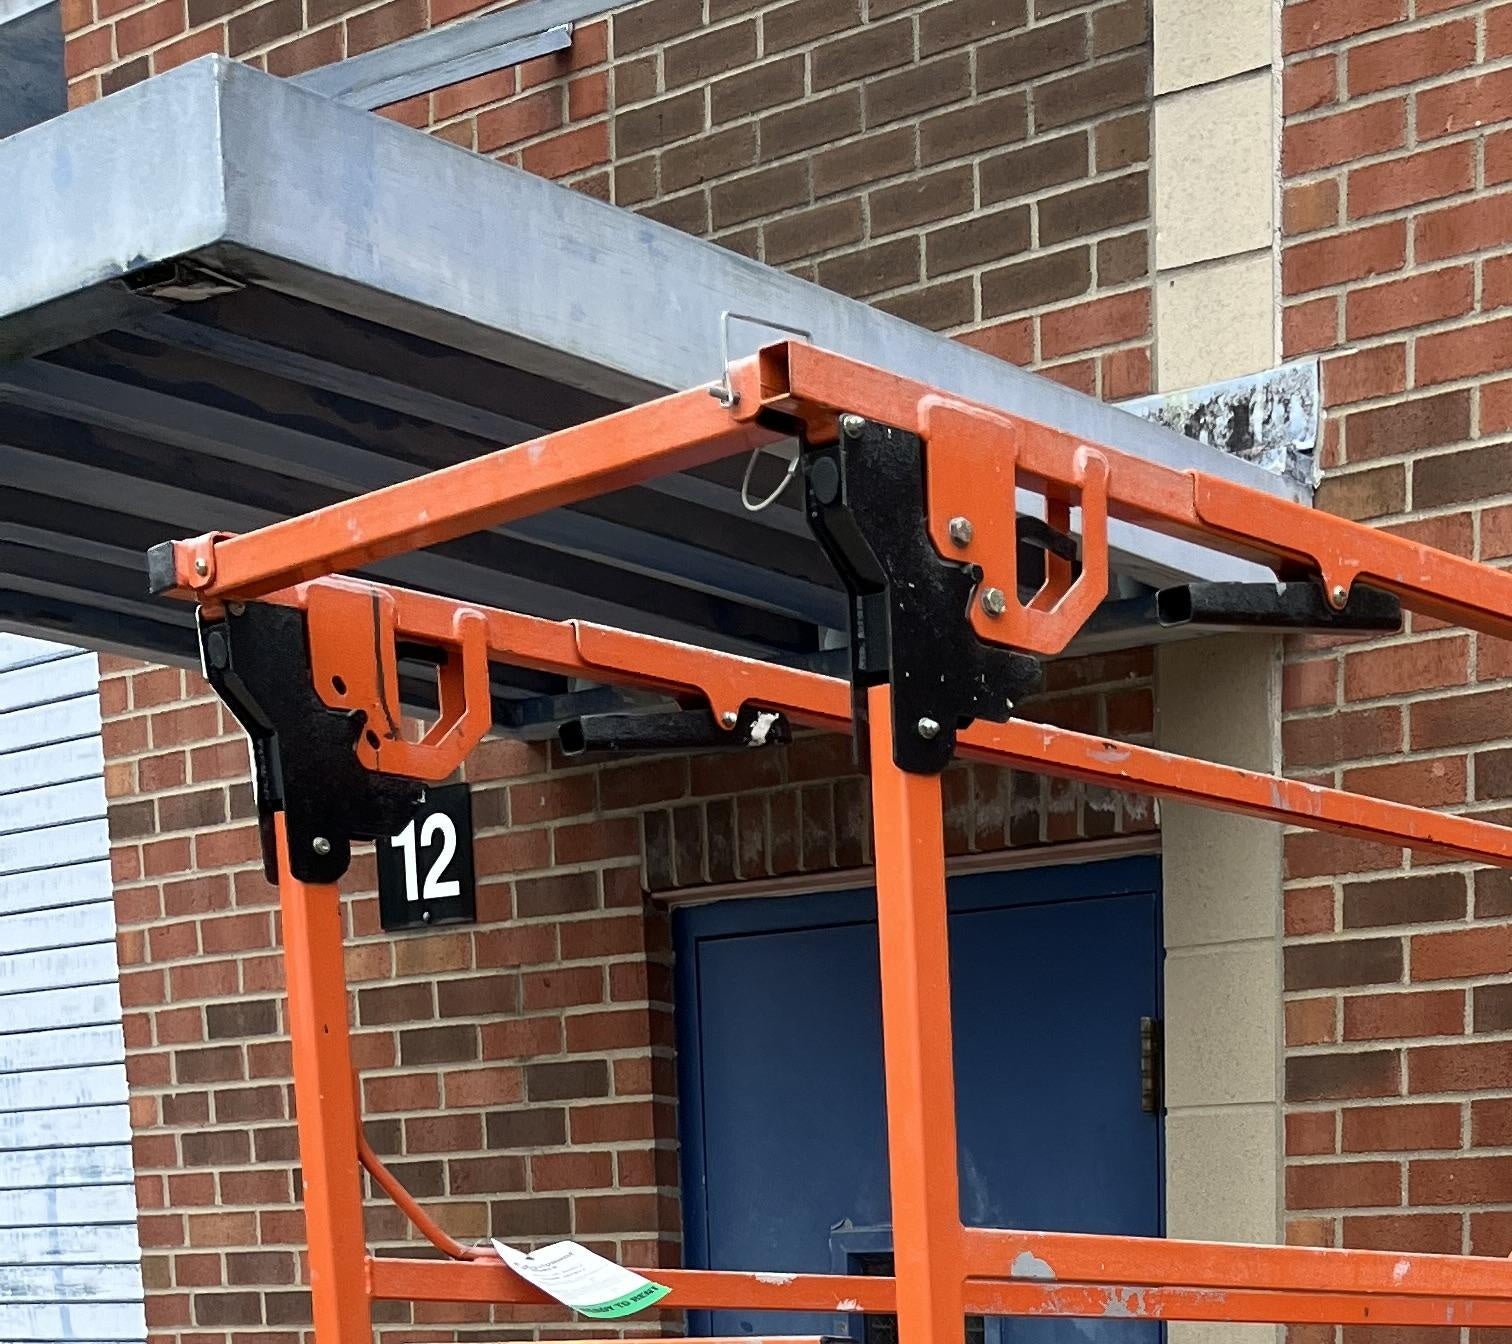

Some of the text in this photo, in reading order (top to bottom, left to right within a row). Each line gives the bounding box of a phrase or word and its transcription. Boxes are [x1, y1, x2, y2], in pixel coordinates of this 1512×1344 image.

[390, 812, 461, 902] 12
[616, 1299, 631, 1312] TO
[632, 1285, 659, 1303] RENT
